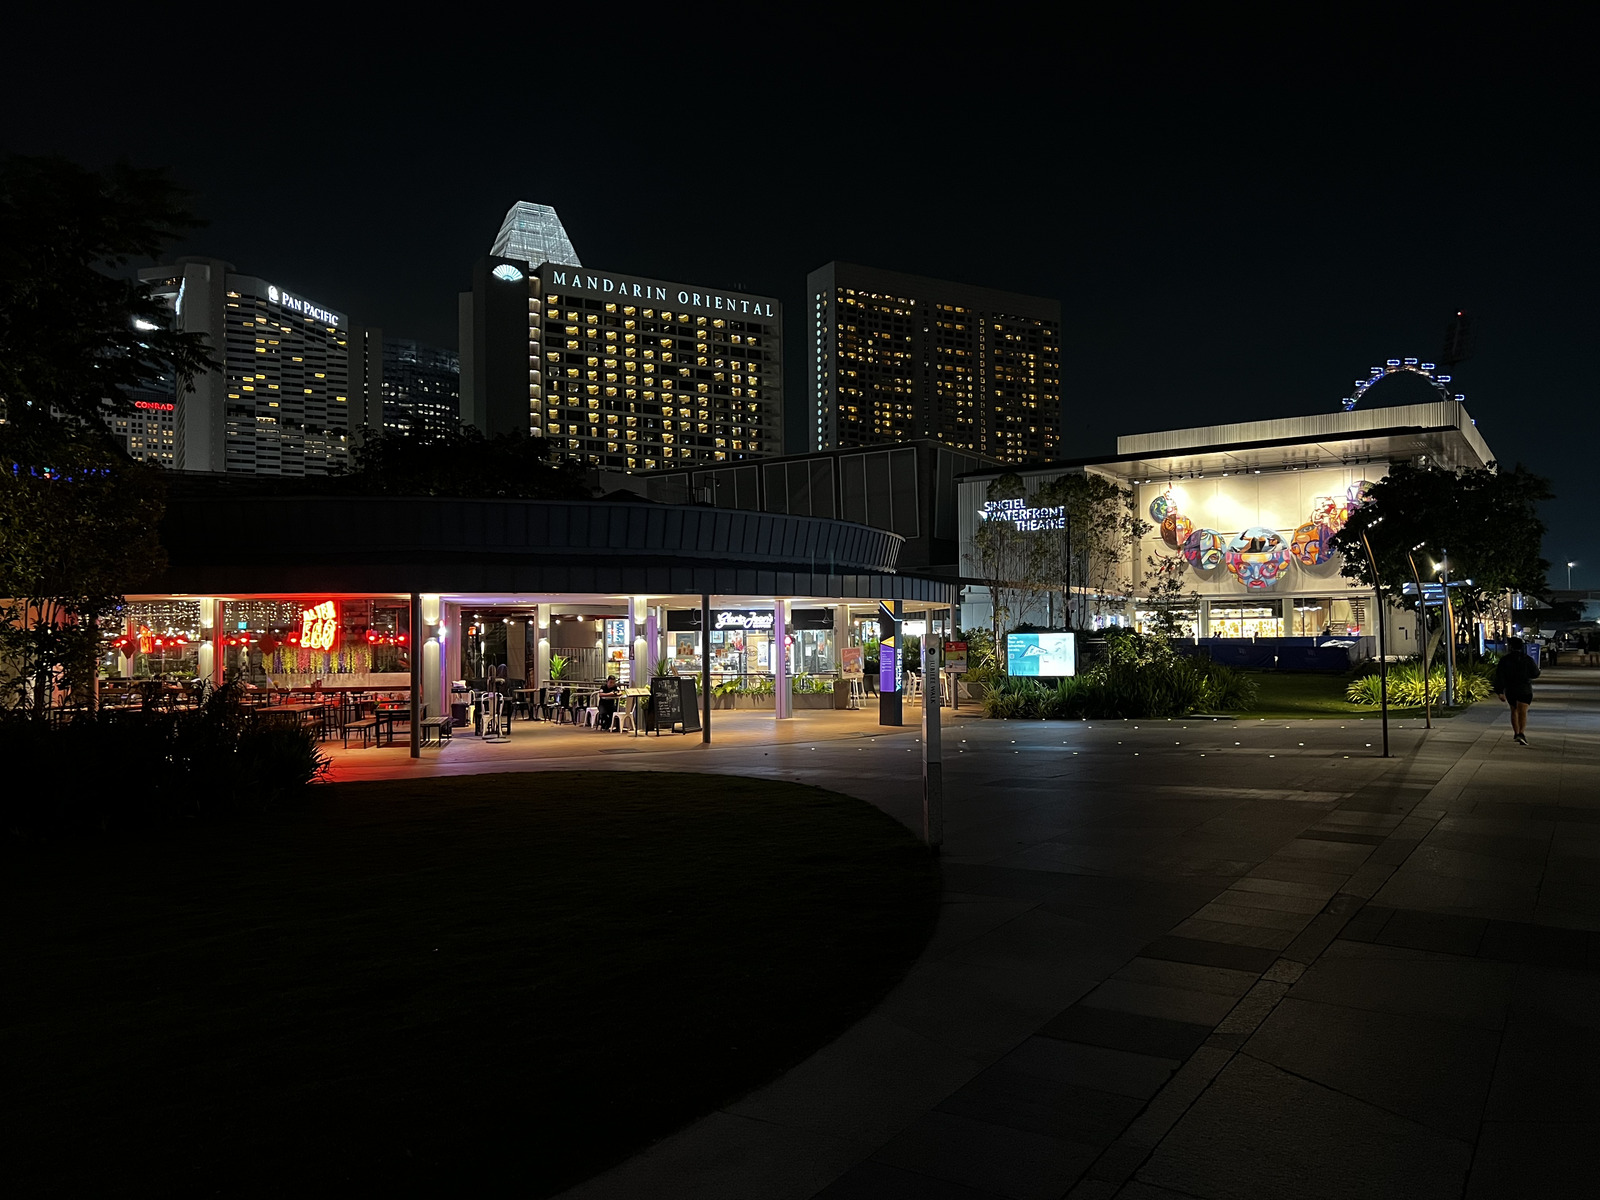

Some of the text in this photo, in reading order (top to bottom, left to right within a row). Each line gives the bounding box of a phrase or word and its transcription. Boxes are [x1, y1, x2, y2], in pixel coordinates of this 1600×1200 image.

[552, 271, 774, 317] MANDARIN ORIENTAL
[282, 291, 338, 326] PAN PACIFIC
[134, 400, 175, 411] CONRAD
[984, 498, 1026, 512] SINGTEL
[988, 506, 1065, 522] WATERFRONT
